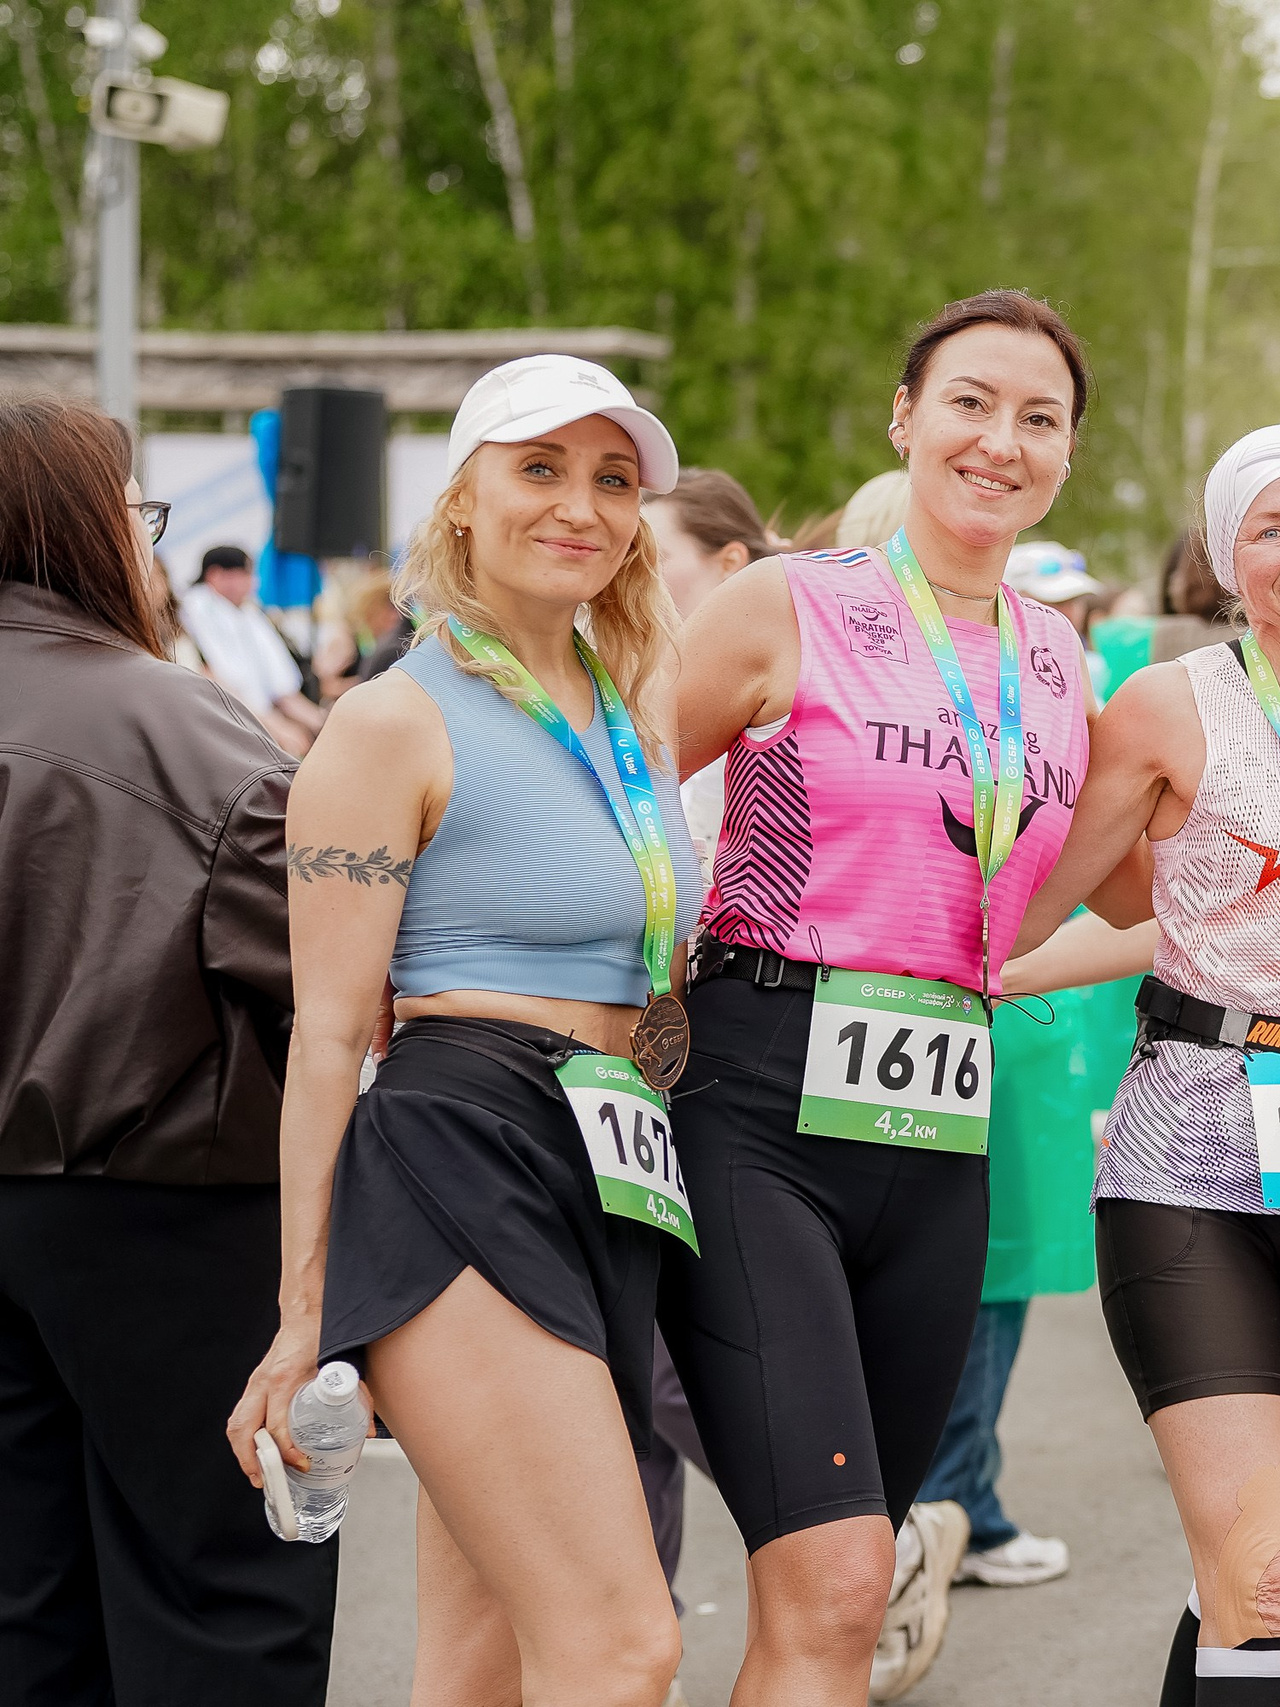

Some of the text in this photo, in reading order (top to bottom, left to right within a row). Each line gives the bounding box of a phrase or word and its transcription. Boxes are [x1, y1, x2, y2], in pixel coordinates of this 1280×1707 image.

[901, 562, 914, 582] 185
[907, 582, 922, 601] лет
[1256, 665, 1269, 682] 185
[952, 683, 966, 705] Utair
[1006, 683, 1016, 705] Utair
[1008, 736, 1020, 765] СБЕР
[622, 751, 639, 776] Utair
[973, 743, 988, 835] СБЕР 185 лет
[1001, 793, 1015, 837] 185 лет
[644, 816, 661, 849] СБЕР
[876, 986, 906, 999] СБЕР
[837, 1020, 979, 1100] 1616
[607, 1069, 630, 1081] СБЕР
